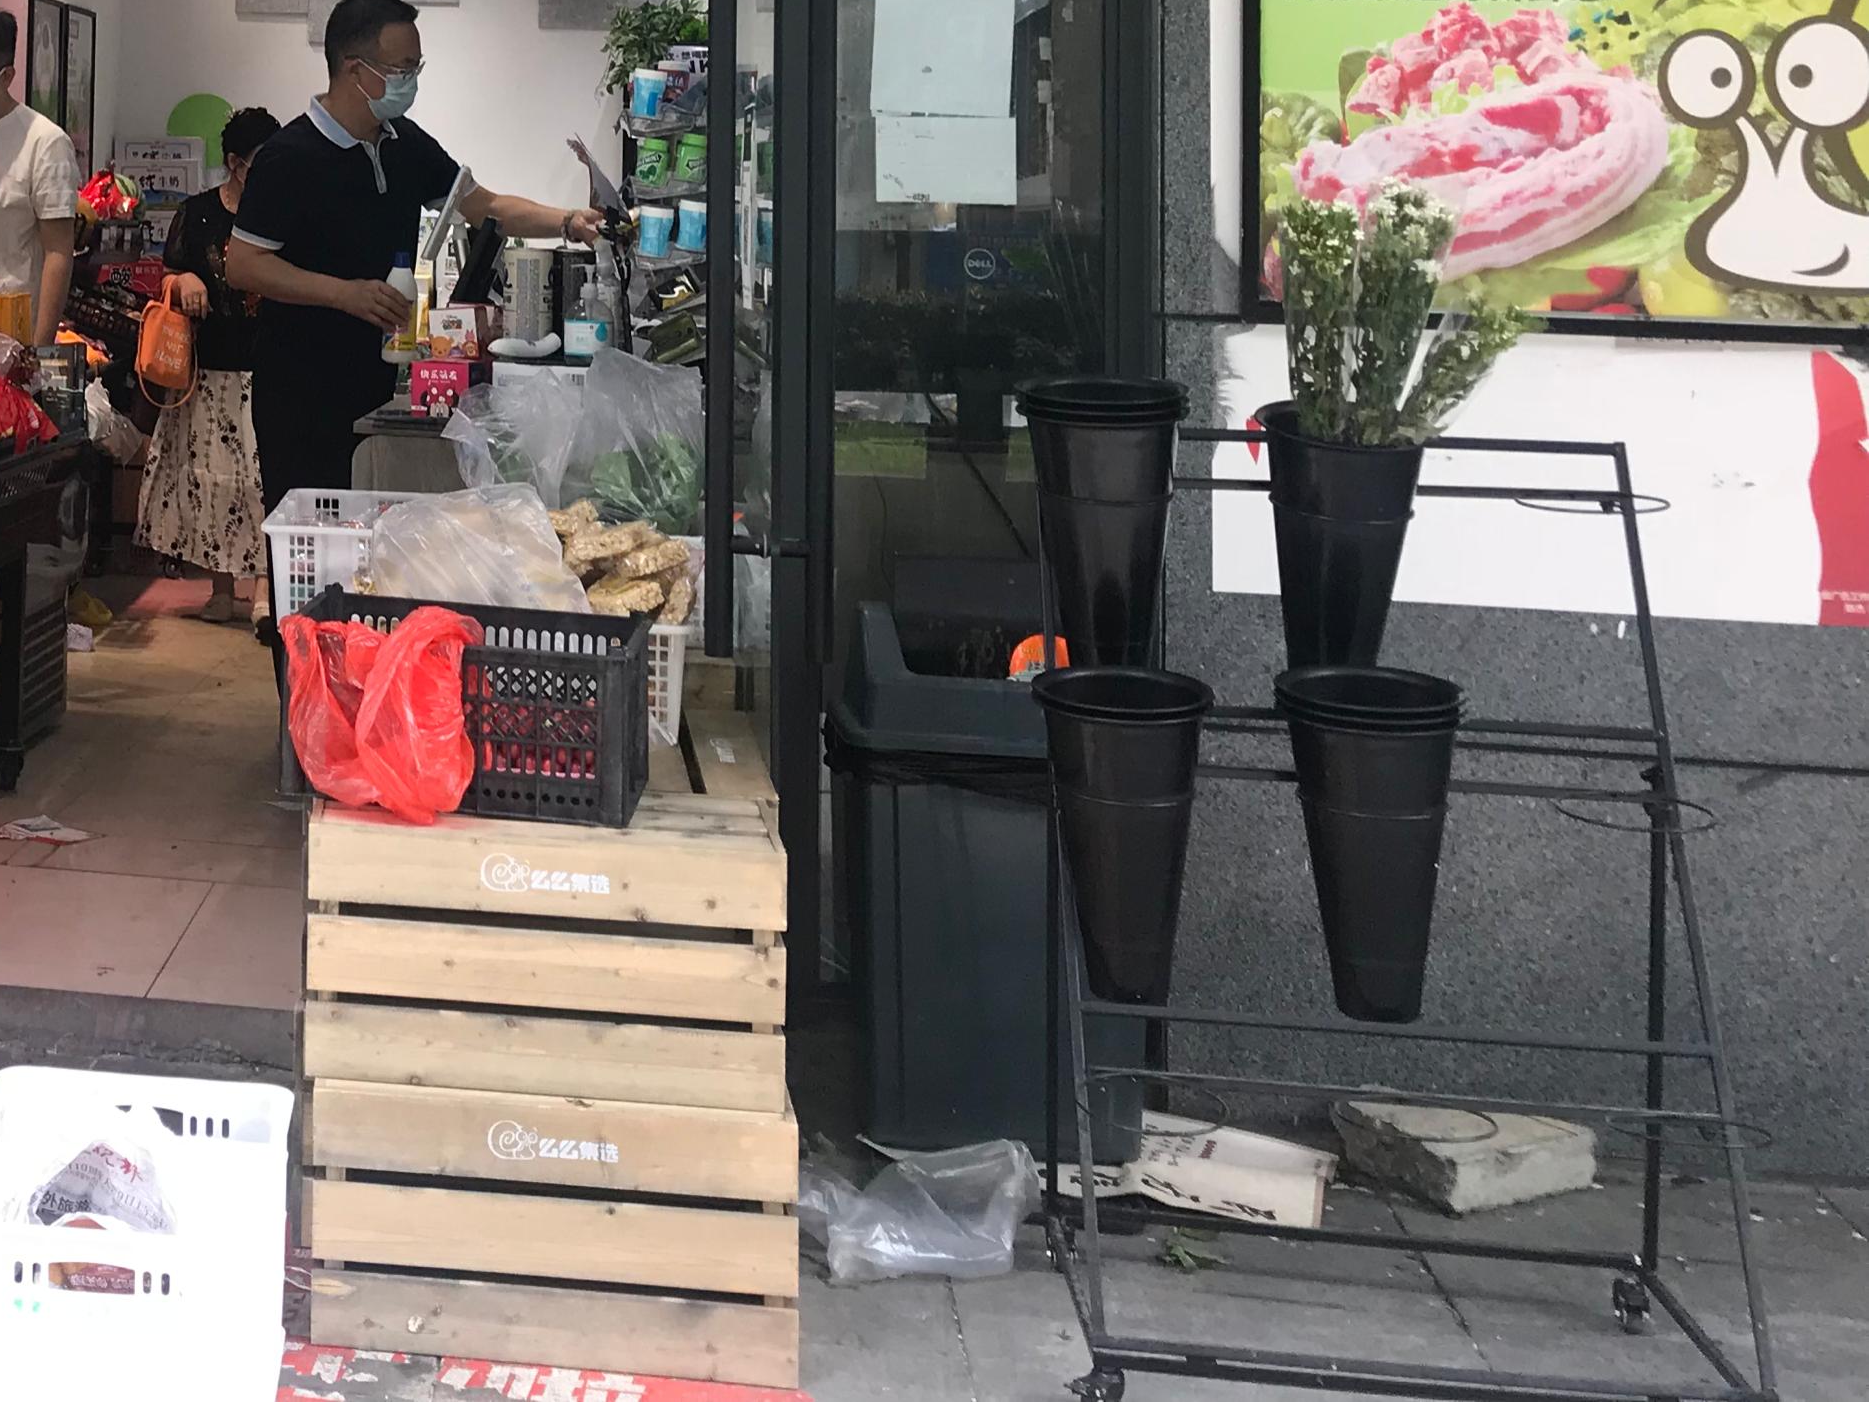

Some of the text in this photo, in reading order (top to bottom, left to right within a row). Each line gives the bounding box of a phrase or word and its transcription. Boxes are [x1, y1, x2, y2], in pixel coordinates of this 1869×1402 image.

[531, 869, 611, 895] 么么集选
[538, 1137, 619, 1163] 么么集选
